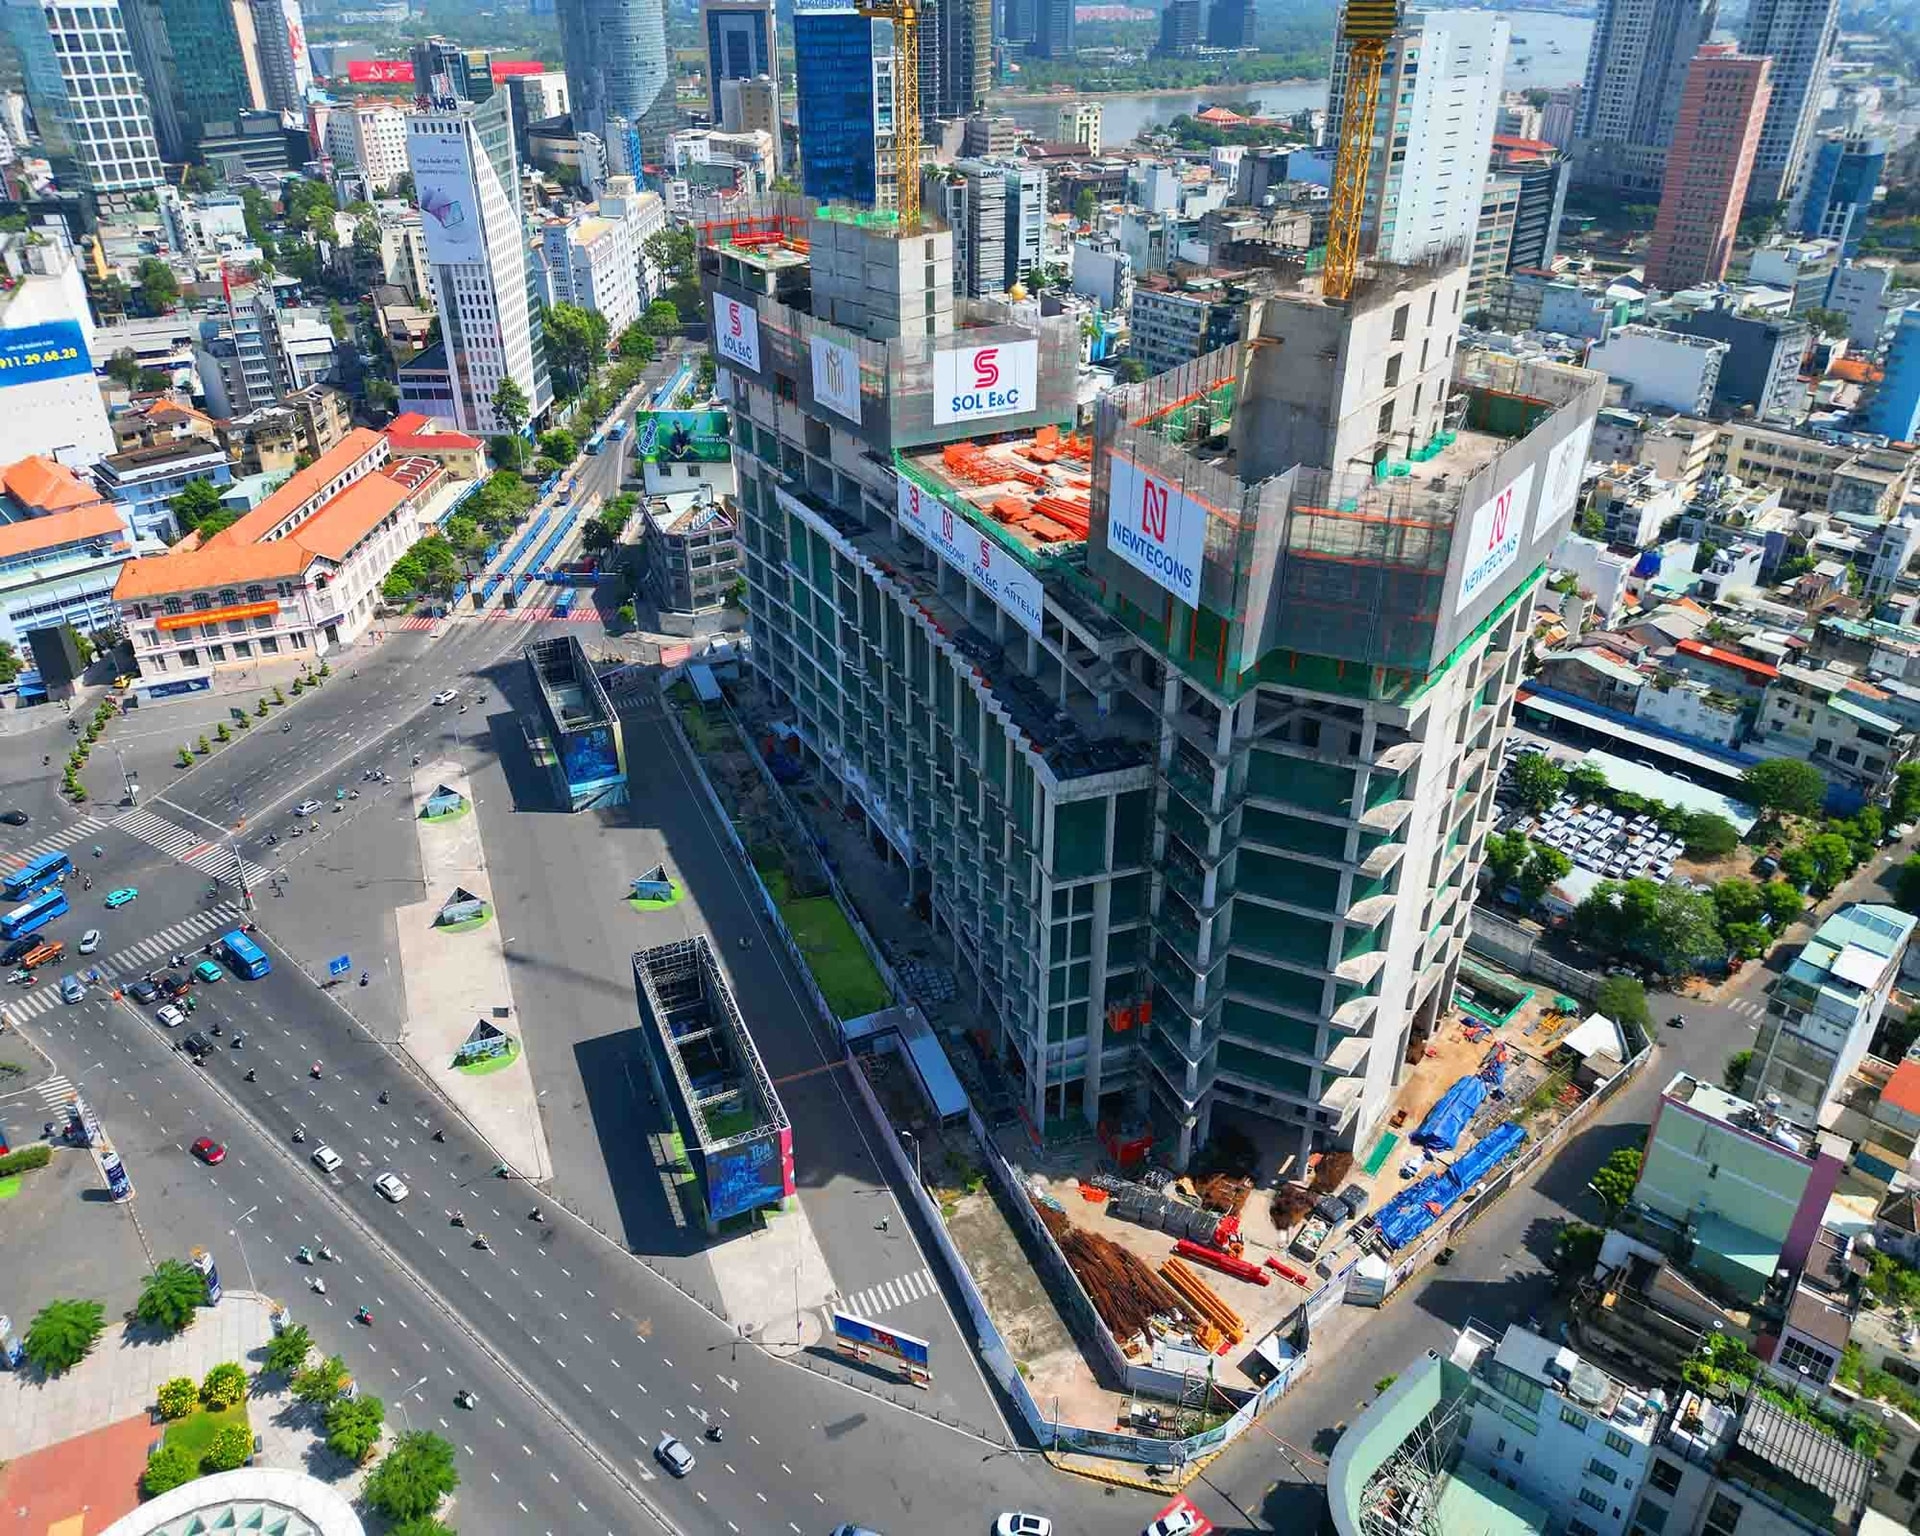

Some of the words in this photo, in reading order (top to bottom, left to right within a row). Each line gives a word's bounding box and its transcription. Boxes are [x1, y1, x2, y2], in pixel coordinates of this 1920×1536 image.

[433, 96, 457, 110] MB
[723, 334, 737, 355] SOL
[952, 394, 983, 412] SOL
[989, 389, 1018, 408] E&C
[931, 530, 967, 564] NEWTECONS
[1113, 521, 1192, 588] NEWTECONS
[973, 562, 984, 581] SOL
[1463, 536, 1517, 593] NEWTECONS
[1004, 586, 1041, 622] ARTELIA
